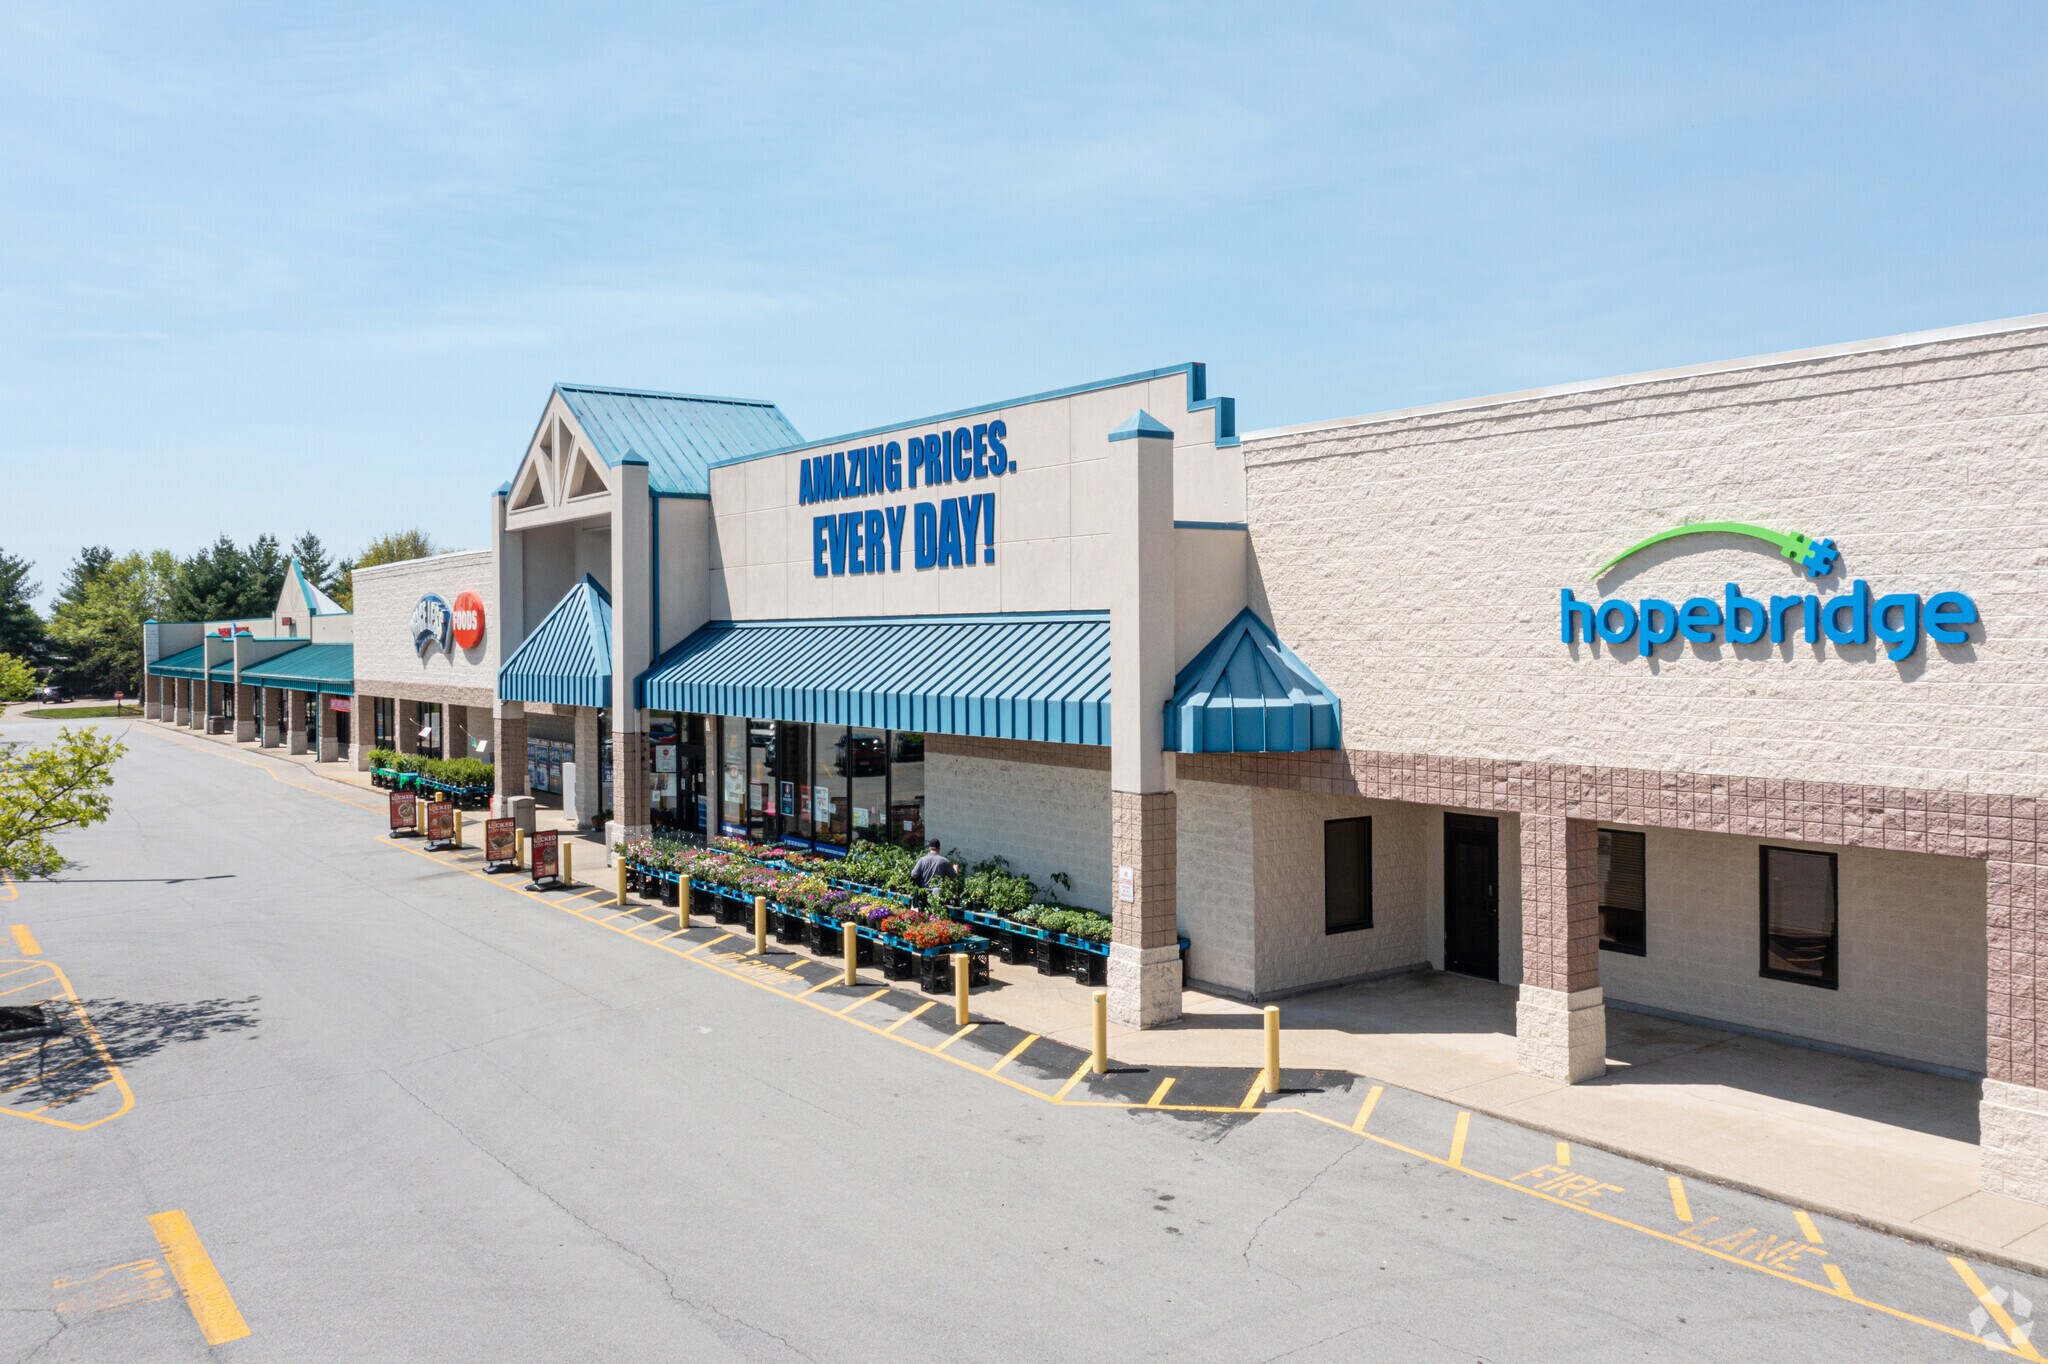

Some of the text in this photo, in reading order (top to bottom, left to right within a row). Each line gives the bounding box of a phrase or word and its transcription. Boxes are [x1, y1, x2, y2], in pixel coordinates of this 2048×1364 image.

[799, 419, 1017, 505] AMAZING PRICES.
[813, 492, 995, 576] EVERY DAY!
[453, 610, 477, 631] FOODS
[1561, 579, 1979, 662] hopebridge
[488, 821, 514, 830] LOCKED
[533, 835, 556, 844] LOCKED
[1510, 1164, 1625, 1205] FIRE
[1676, 1215, 1829, 1272] LANE
